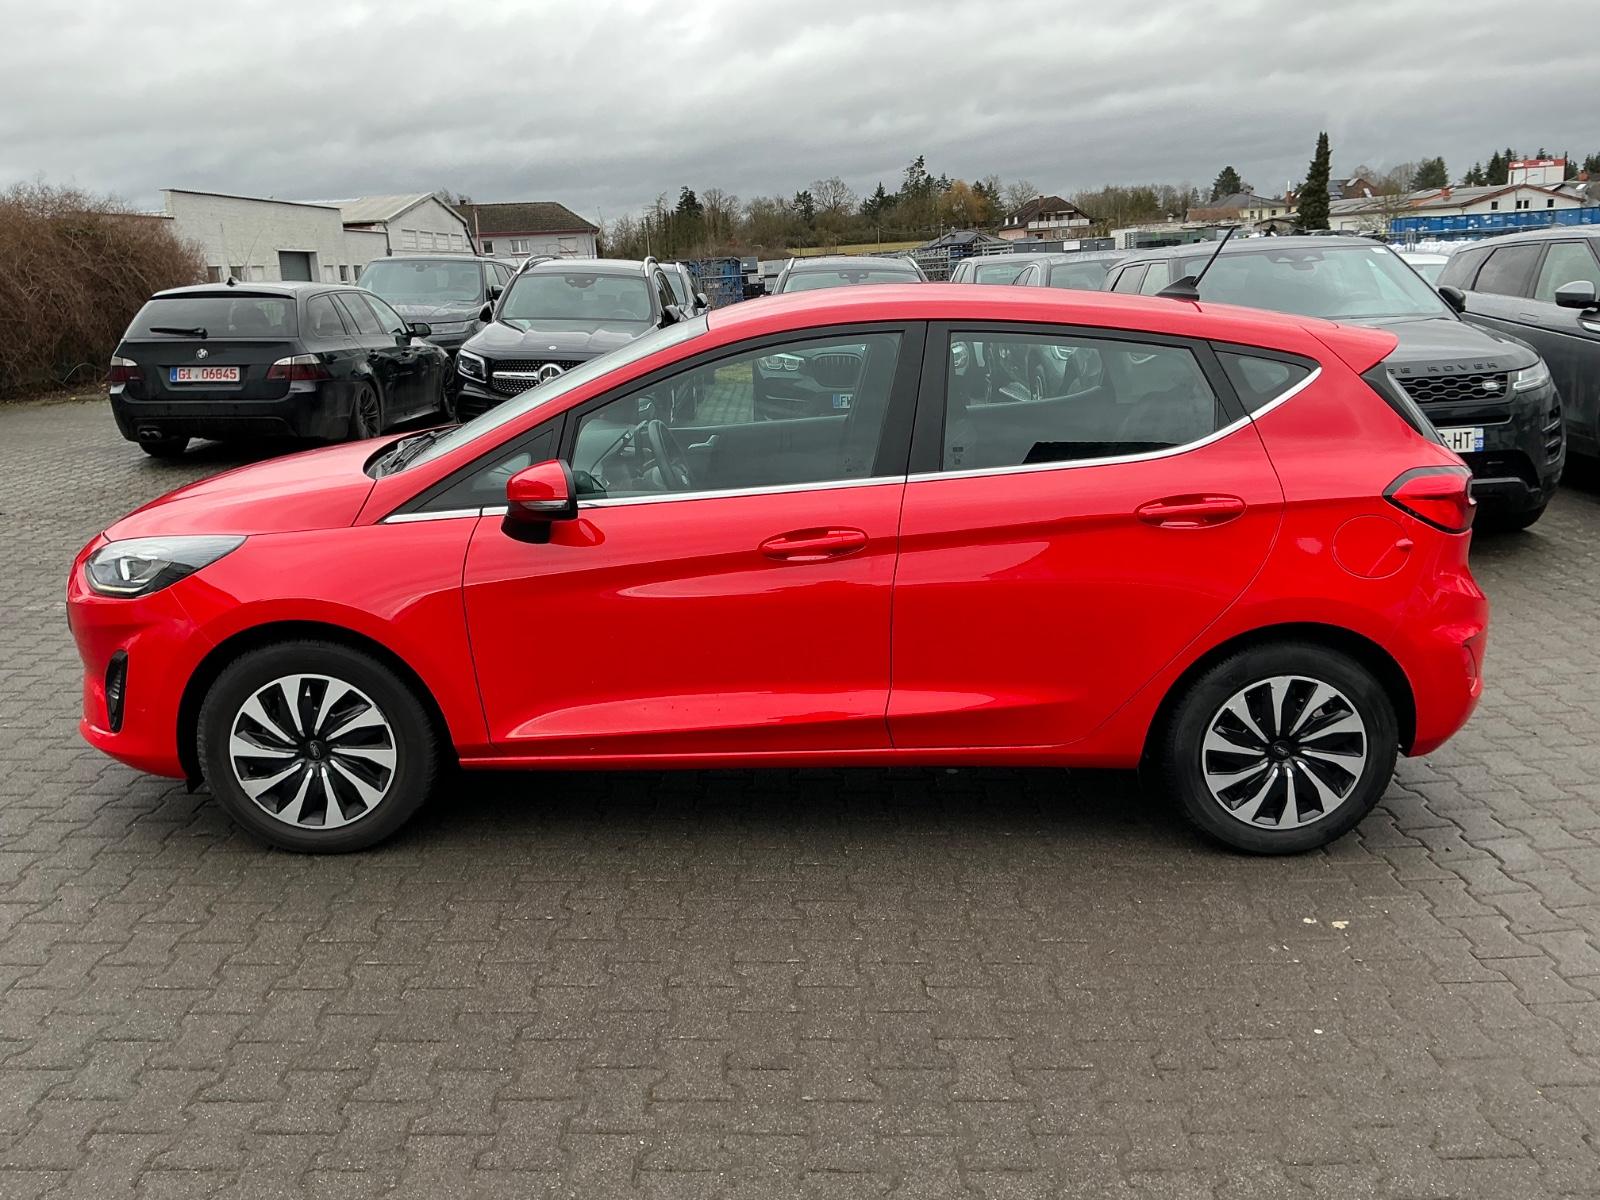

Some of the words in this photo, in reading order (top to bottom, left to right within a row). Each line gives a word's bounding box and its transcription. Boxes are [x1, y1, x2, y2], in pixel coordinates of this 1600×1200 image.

[1427, 362, 1499, 373] ROVER
[178, 368, 192, 380] GI
[201, 368, 237, 380] 06845
